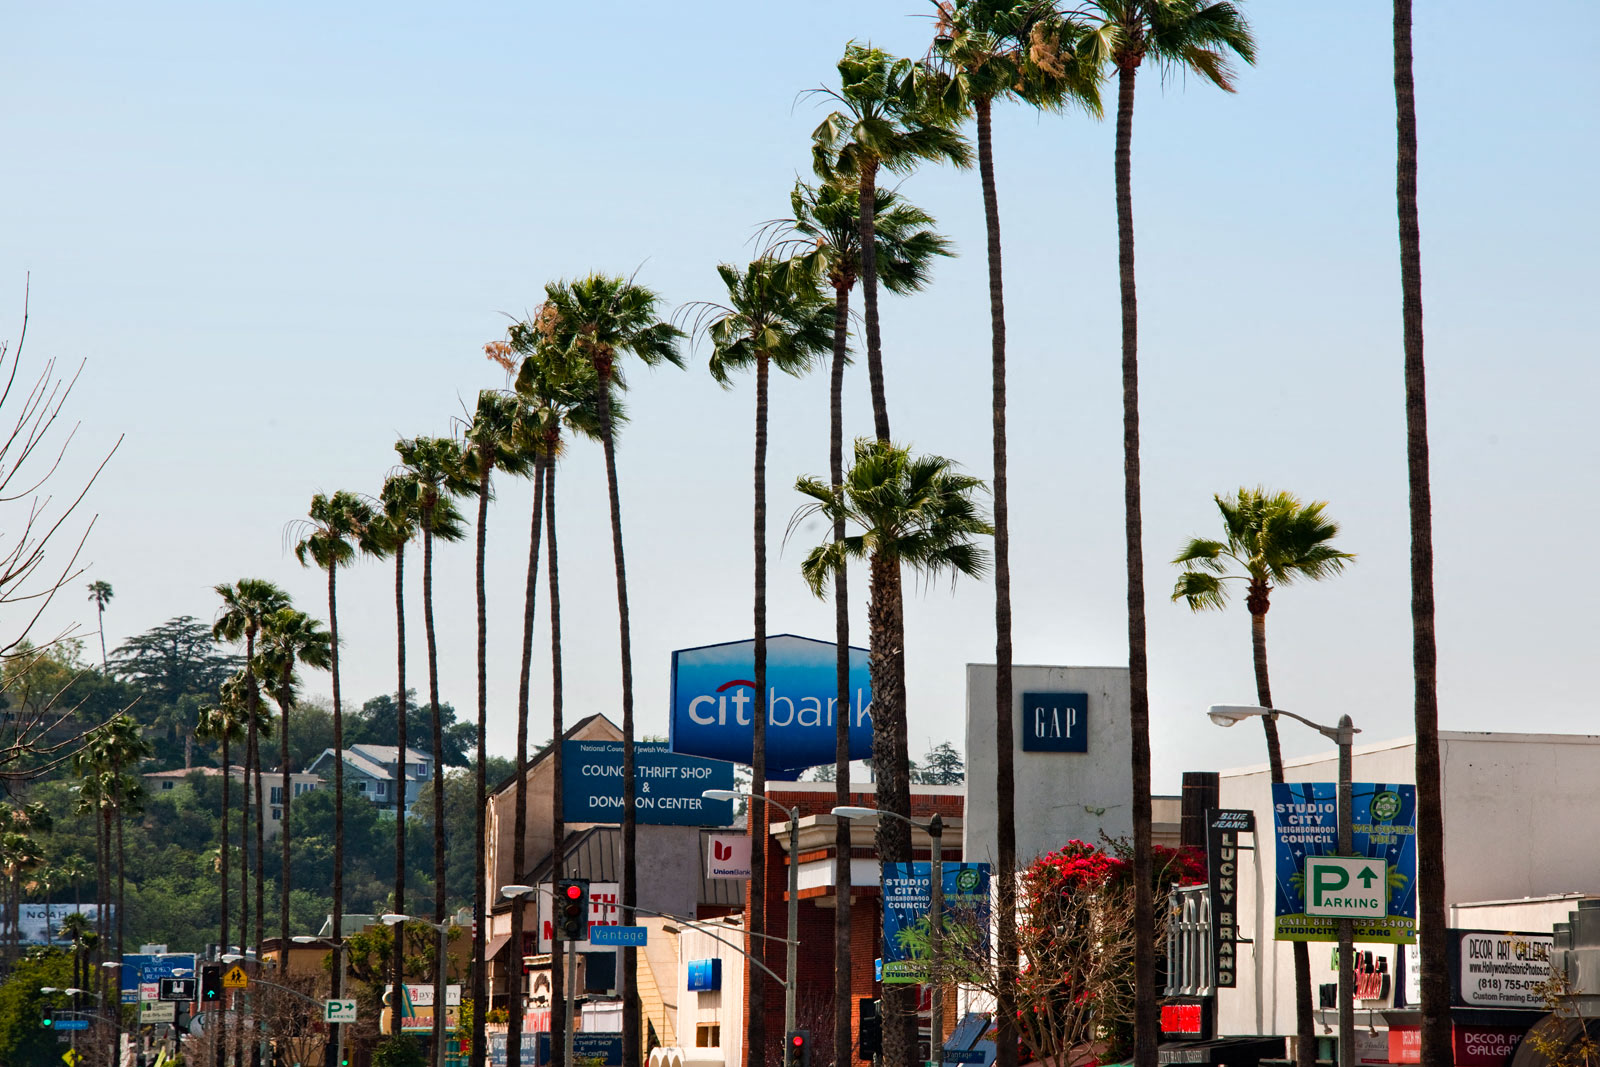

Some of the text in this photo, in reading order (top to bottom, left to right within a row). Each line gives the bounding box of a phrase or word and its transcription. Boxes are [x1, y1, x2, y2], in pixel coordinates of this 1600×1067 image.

[688, 686, 873, 728] citbank
[1035, 706, 1076, 738] GAP
[580, 744, 605, 752] National
[637, 746, 656, 755] Jewish
[638, 766, 678, 778] THRIFT
[680, 767, 713, 779] SHOP
[642, 782, 651, 793] &
[589, 795, 703, 810] DONAON CENTER
[1275, 803, 1335, 814] STUDIO
[1219, 812, 1248, 820] BLUE
[1288, 815, 1323, 825] CITY
[1211, 820, 1249, 829] JEANS
[1277, 826, 1336, 834] NEIGHBORHOOD
[1352, 823, 1415, 835] WELCOMES
[1280, 835, 1334, 844] COUNCIL
[713, 868, 751, 876] UnionBank
[886, 878, 930, 886] STUDIO
[1313, 864, 1379, 909] PARKING
[894, 887, 921, 895] CITY
[1219, 833, 1235, 985] LUCKY BRAND
[26, 911, 67, 919] NOAH
[1279, 918, 1310, 926] CALL
[594, 930, 644, 943] Vantage
[1469, 939, 1493, 960] DECOR
[1497, 940, 1510, 960] ART
[1478, 978, 1502, 991] (818)
[1472, 991, 1498, 1000] Custom
[1499, 993, 1526, 1003] Framing
[1464, 1032, 1505, 1044] DECOR
[1466, 1045, 1514, 1056] GALLER
